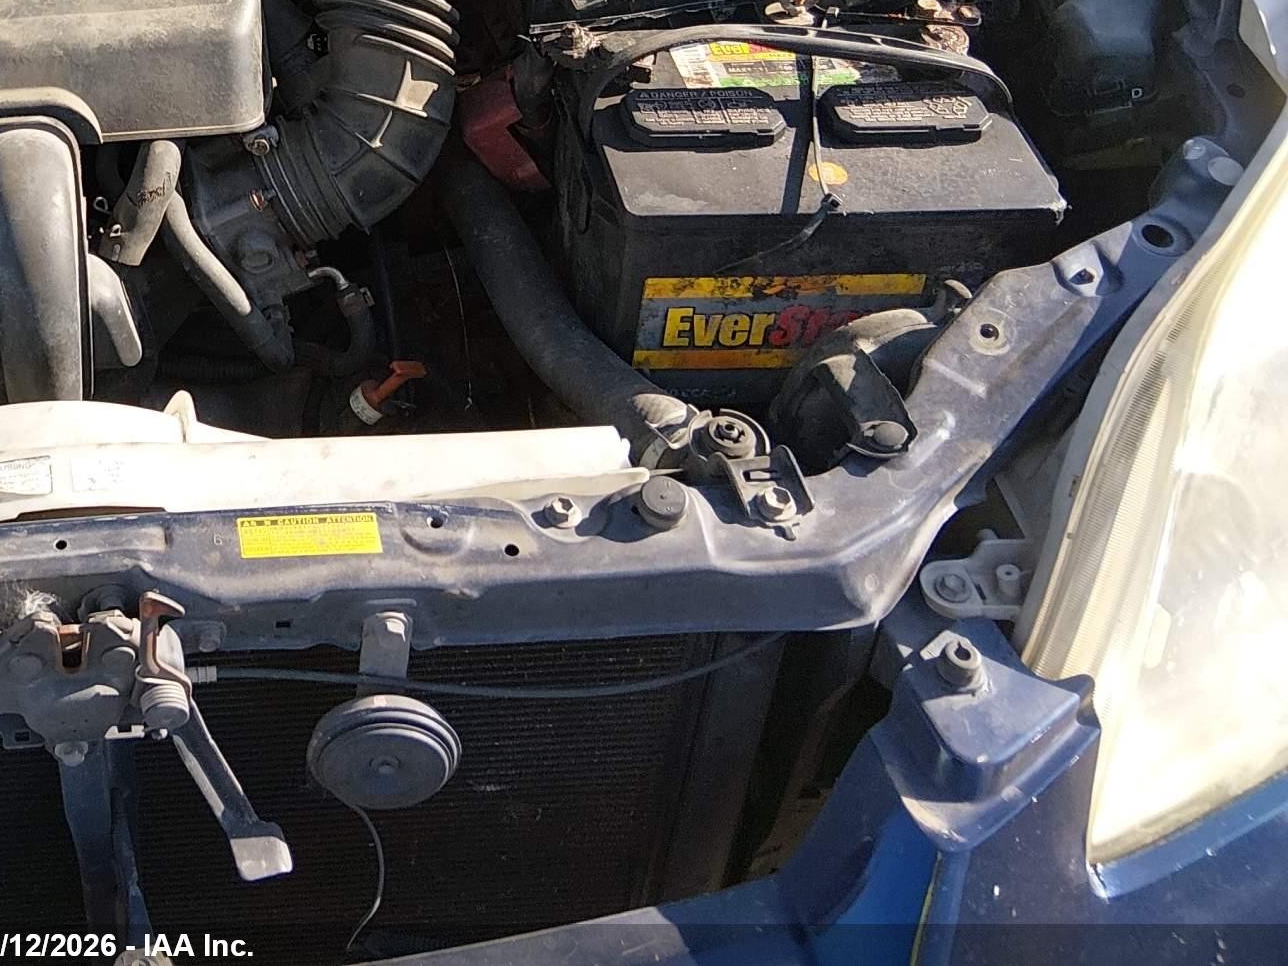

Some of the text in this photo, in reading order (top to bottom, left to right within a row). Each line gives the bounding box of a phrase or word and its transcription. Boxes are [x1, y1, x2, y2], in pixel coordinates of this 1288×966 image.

[649, 90, 697, 99] DANGER
[709, 89, 753, 98] POISON
[277, 517, 320, 526] CAUTION
[326, 515, 373, 524] ATTENTION
